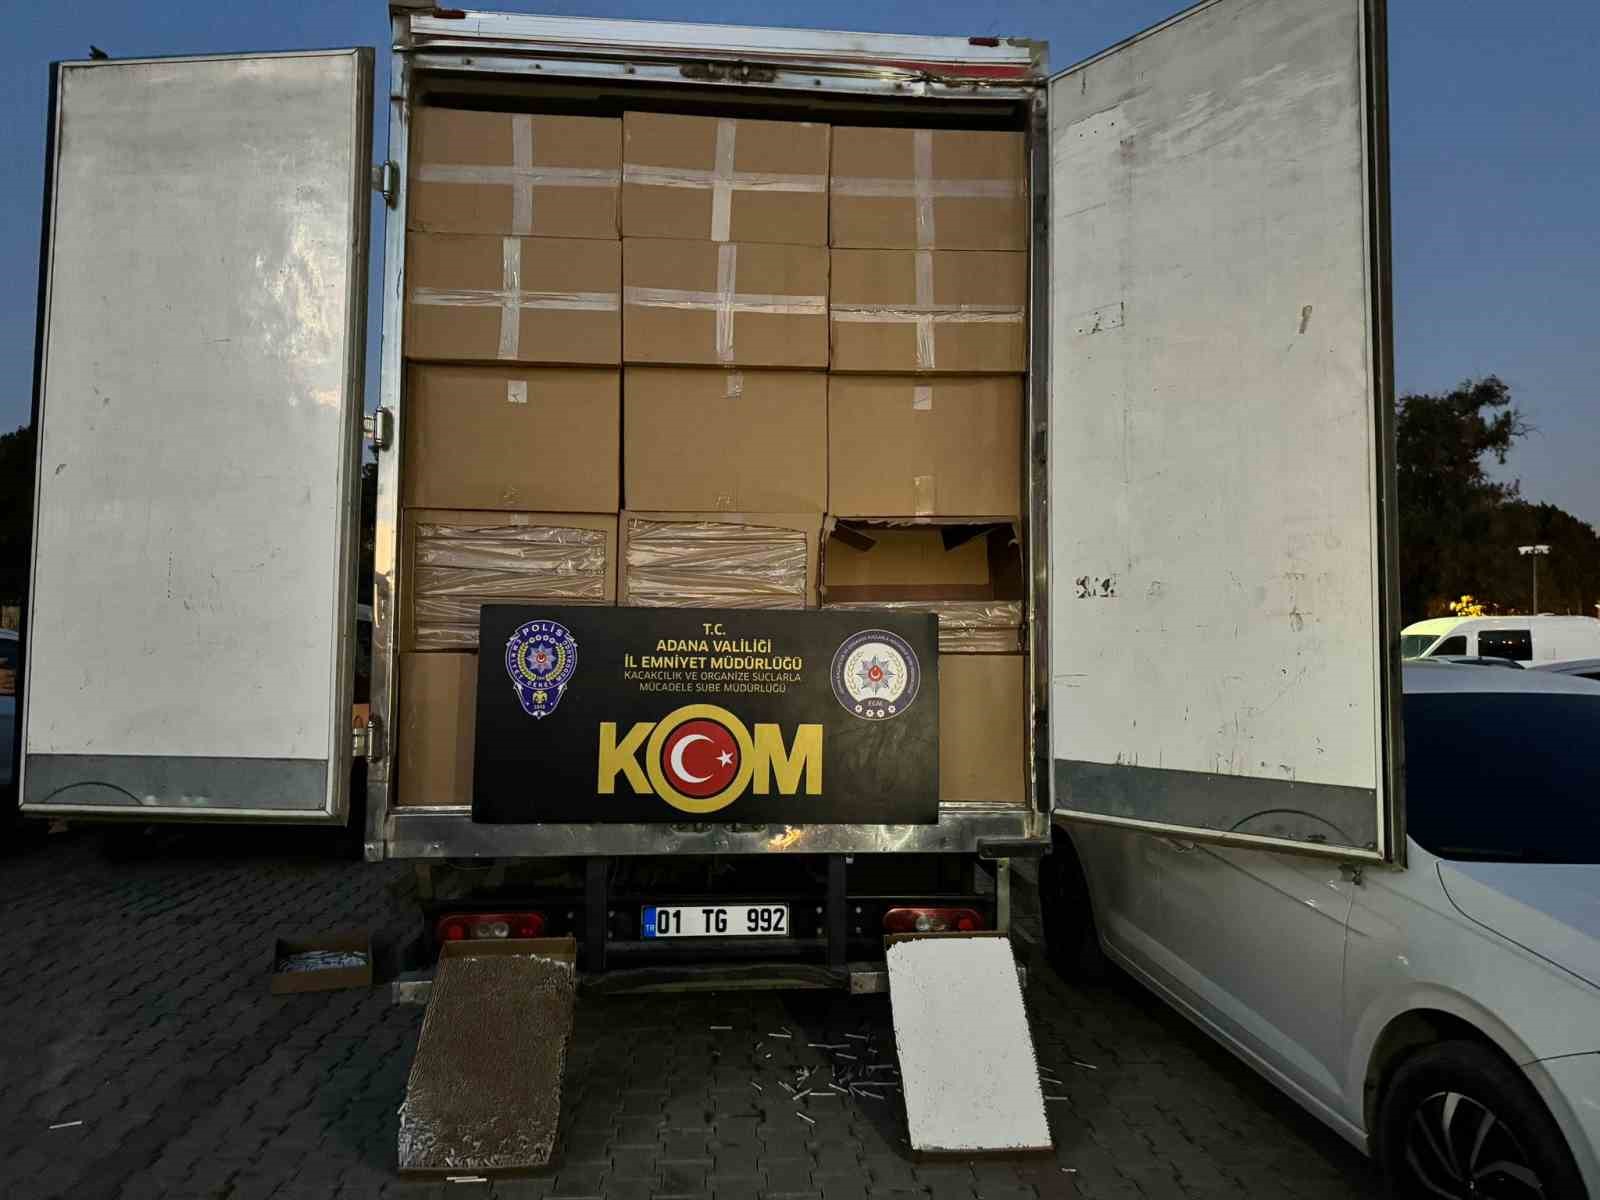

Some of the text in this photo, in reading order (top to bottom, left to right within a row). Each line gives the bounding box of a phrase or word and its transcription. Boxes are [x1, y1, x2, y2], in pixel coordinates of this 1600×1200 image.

[521, 623, 564, 637] POLİS
[703, 623, 726, 636] T.C.
[656, 638, 772, 653] ADANA VALİLİĞİ
[624, 653, 803, 670] İL EMNİYET MÜDÜRLÜĞÜ
[685, 671, 697, 681] VE
[597, 703, 824, 814] KOM
[657, 909, 681, 934] 01
[702, 908, 728, 933] TG
[746, 907, 785, 932] 992
